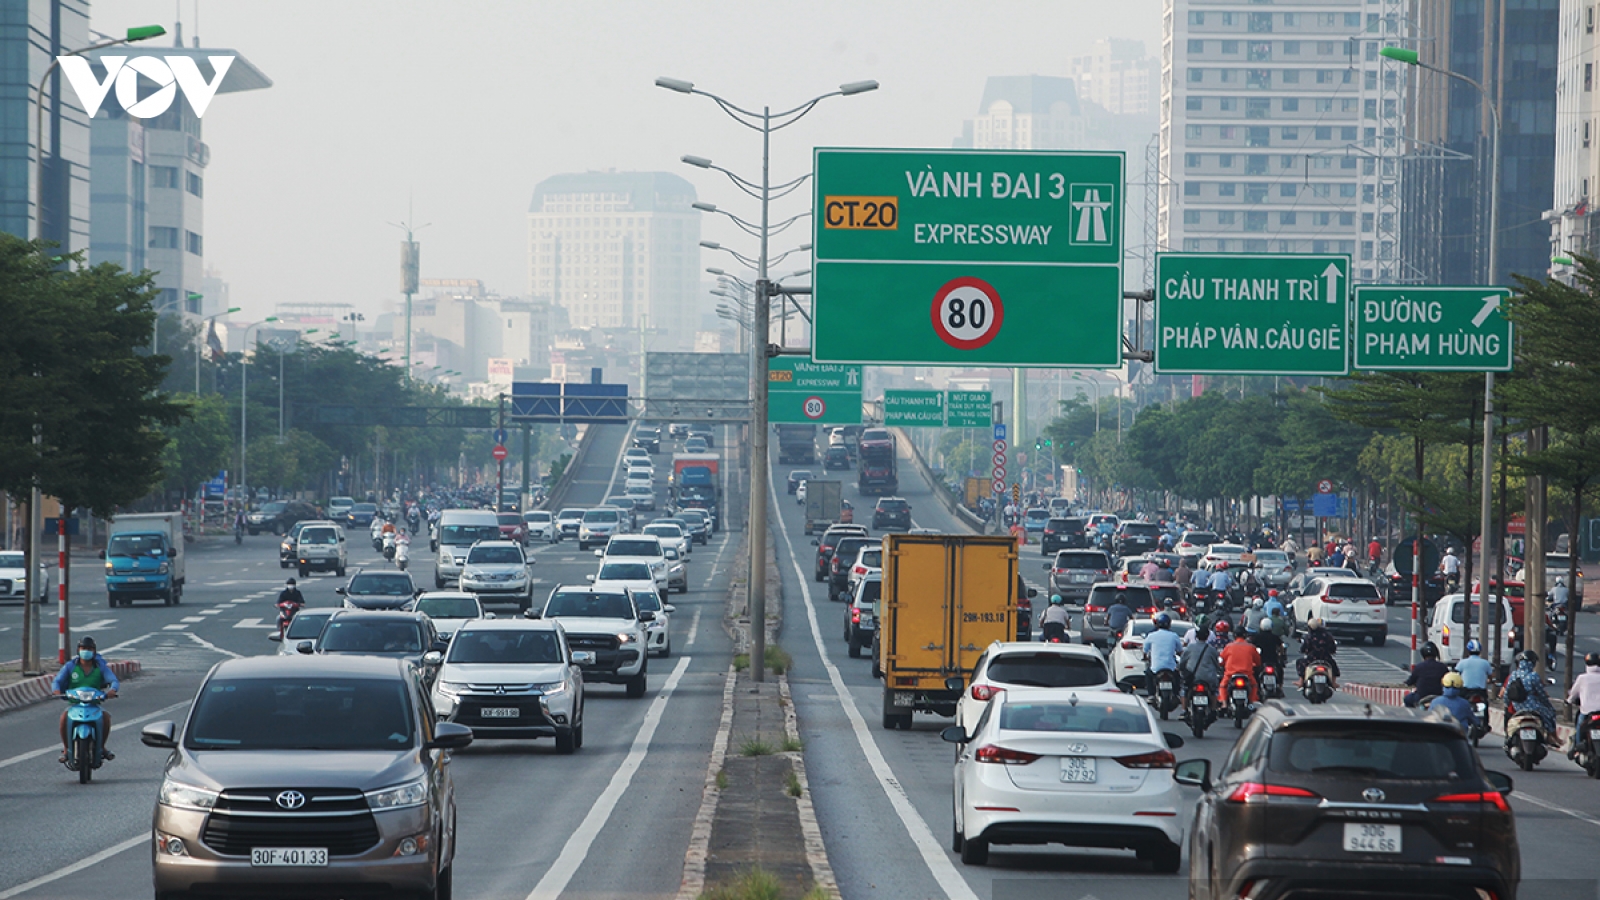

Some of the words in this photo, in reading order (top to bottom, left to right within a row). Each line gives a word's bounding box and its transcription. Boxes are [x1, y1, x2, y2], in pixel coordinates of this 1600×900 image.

[906, 165, 982, 198] VÀNH
[991, 172, 1041, 199] ĐAI
[1048, 172, 1065, 200] 3
[826, 201, 896, 227] CT.20
[914, 224, 1053, 245] EXPRESSWAY
[1164, 271, 1205, 300] CẦU
[1211, 278, 1279, 301] THANH
[1285, 275, 1319, 301] TRÌ
[948, 298, 986, 329] 80
[1364, 295, 1442, 323] ĐƯỜNG
[1163, 322, 1217, 349] PHÁP
[1308, 324, 1341, 350] GIẼ
[1365, 332, 1430, 359] PHẠM
[1438, 328, 1500, 356] HÙNG
[796, 378, 841, 387] EXPRESSWAY
[807, 402, 821, 413] 80
[963, 612, 1005, 623] 29H-193.18
[1068, 758, 1088, 769] 30E
[1360, 824, 1385, 837] 30G
[1350, 837, 1396, 851] 944.66
[253, 849, 326, 864] 30F-401.33
